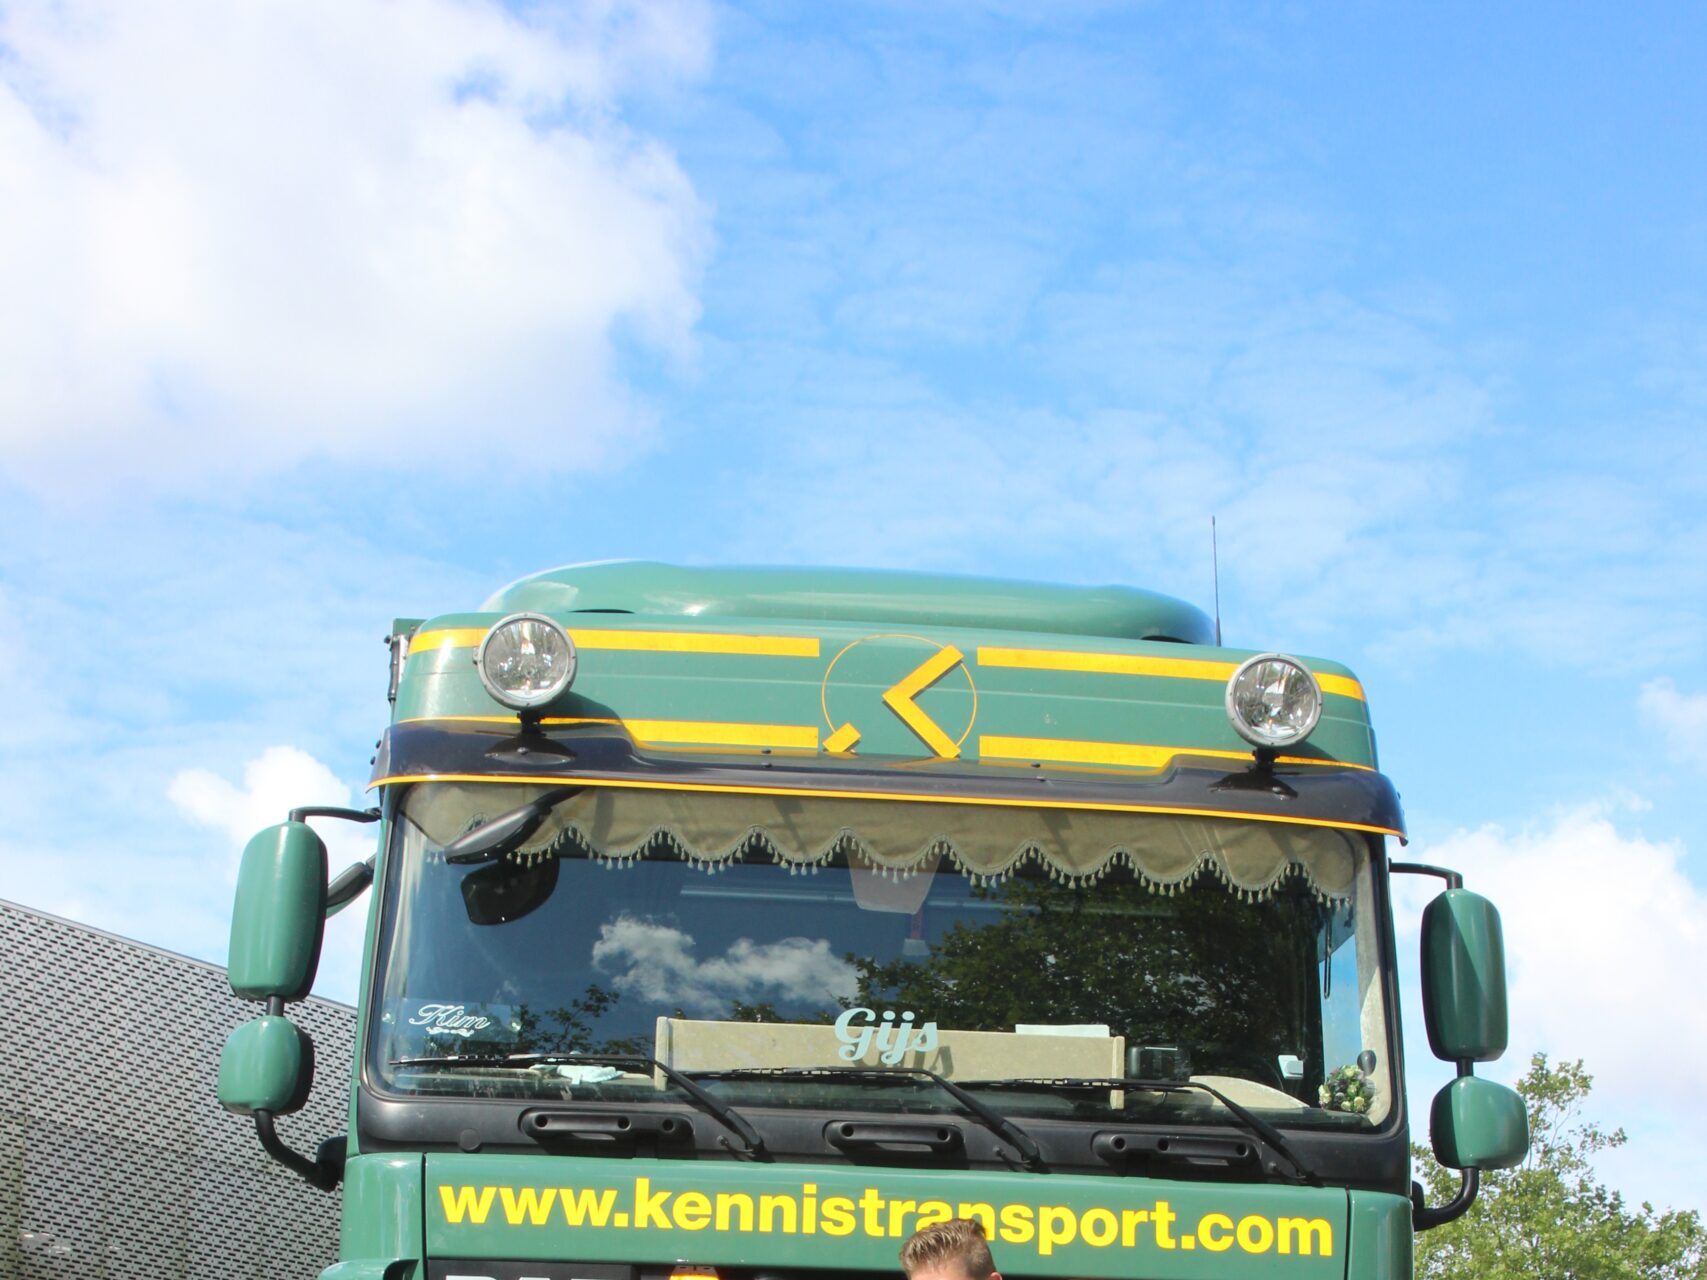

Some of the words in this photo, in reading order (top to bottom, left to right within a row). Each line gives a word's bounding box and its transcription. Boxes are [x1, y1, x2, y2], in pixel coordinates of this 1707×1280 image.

[408, 1004, 491, 1029] Kim
[834, 1007, 939, 1065] Gijs
[438, 1177, 1334, 1257] www.kennistransport.com
